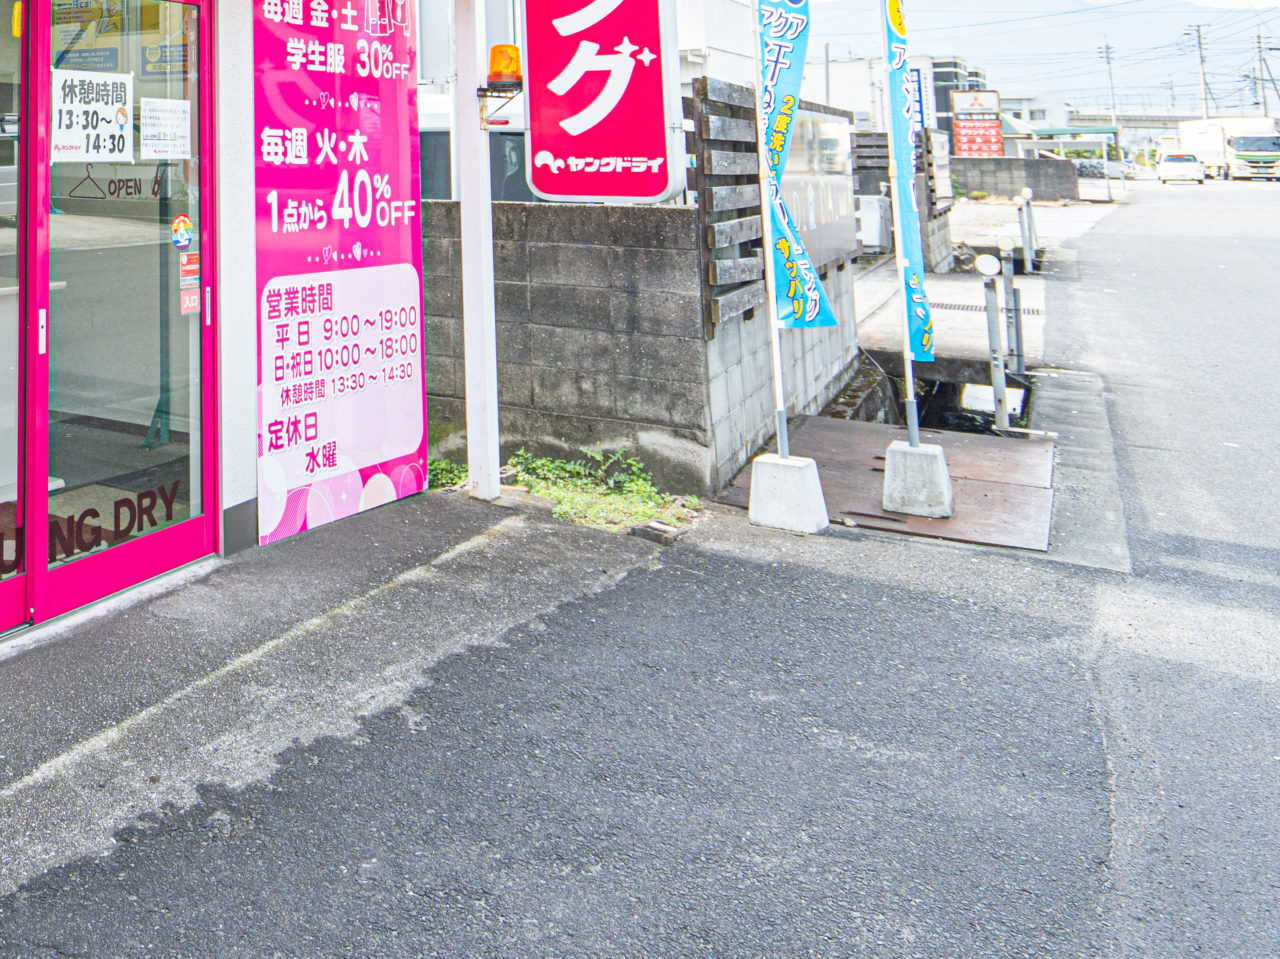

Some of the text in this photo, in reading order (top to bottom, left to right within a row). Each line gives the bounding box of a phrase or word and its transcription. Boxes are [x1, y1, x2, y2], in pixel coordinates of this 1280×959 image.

[286, 37, 345, 74] 学生服
[61, 79, 127, 106] 休憩時間
[85, 134, 125, 154] 14:30
[260, 126, 308, 165] 毎週
[566, 155, 665, 175] ヤングドライ
[108, 178, 141, 198] OPEN
[266, 190, 327, 233] 1点から
[184, 295, 198, 308] 入口
[266, 282, 333, 319] 営業時間
[275, 320, 310, 351] 平日
[280, 380, 326, 408] 休憩時間
[267, 412, 318, 451] 定休日
[305, 441, 337, 474] 水曜
[114, 480, 180, 537] DRY
